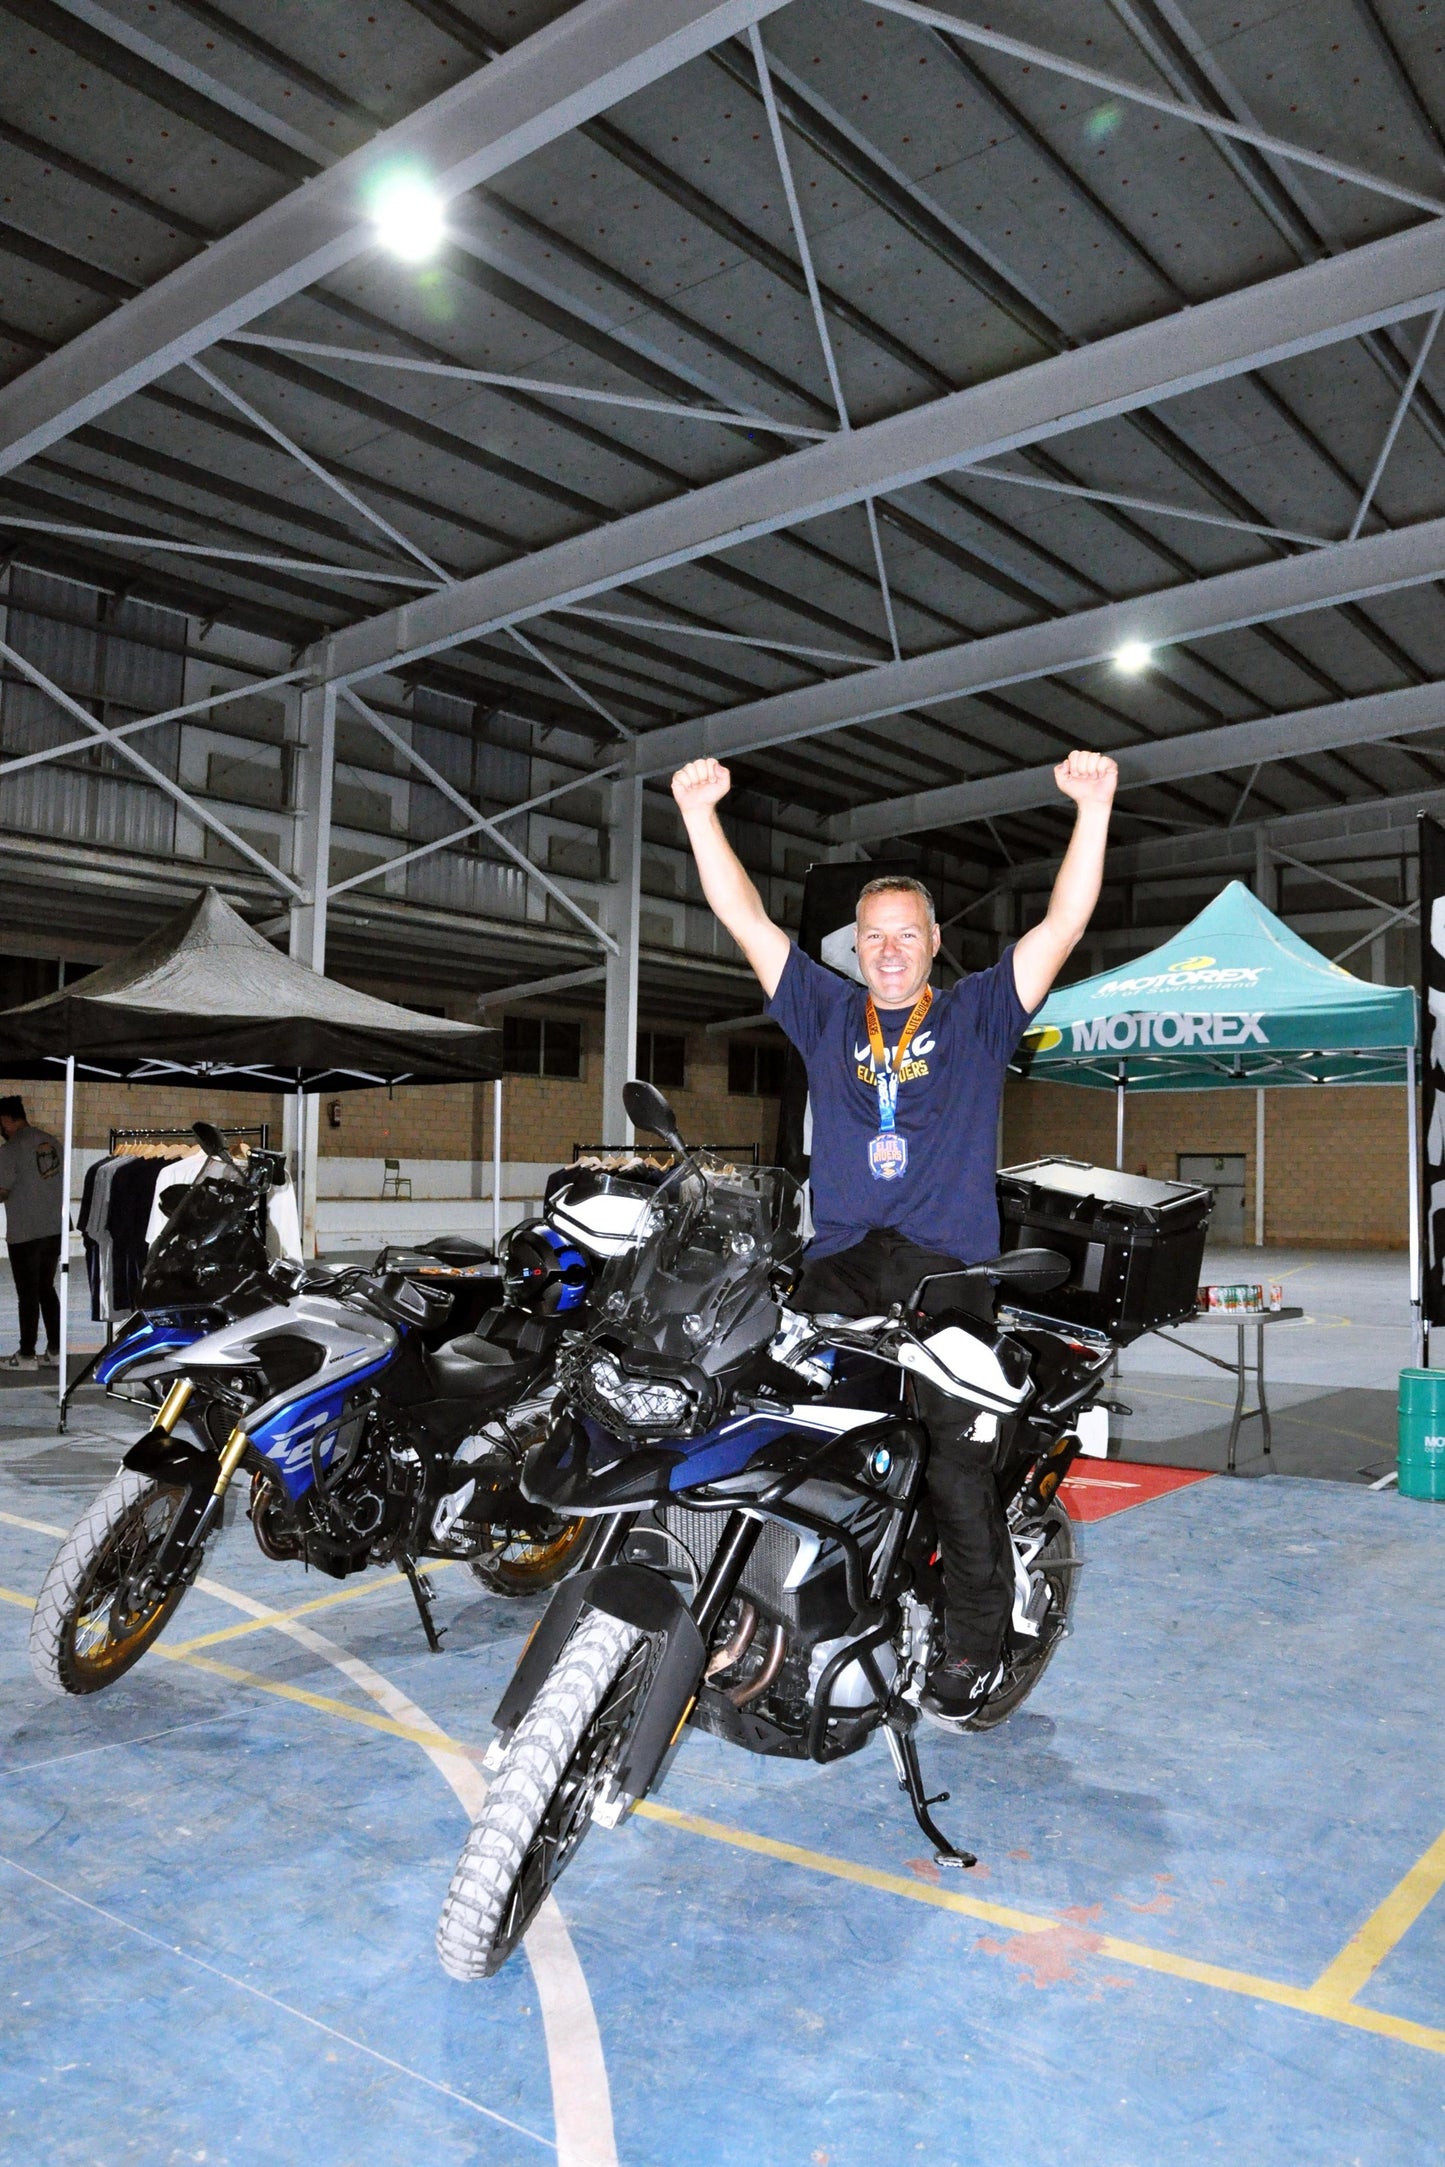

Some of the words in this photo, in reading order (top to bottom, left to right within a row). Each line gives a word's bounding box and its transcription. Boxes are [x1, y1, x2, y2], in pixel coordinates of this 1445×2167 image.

[1098, 967, 1266, 993] MOTOREX
[1146, 980, 1259, 995] Switzerland
[1071, 1011, 1270, 1052] MOTOREX
[1424, 1436, 1445, 1447] MO
